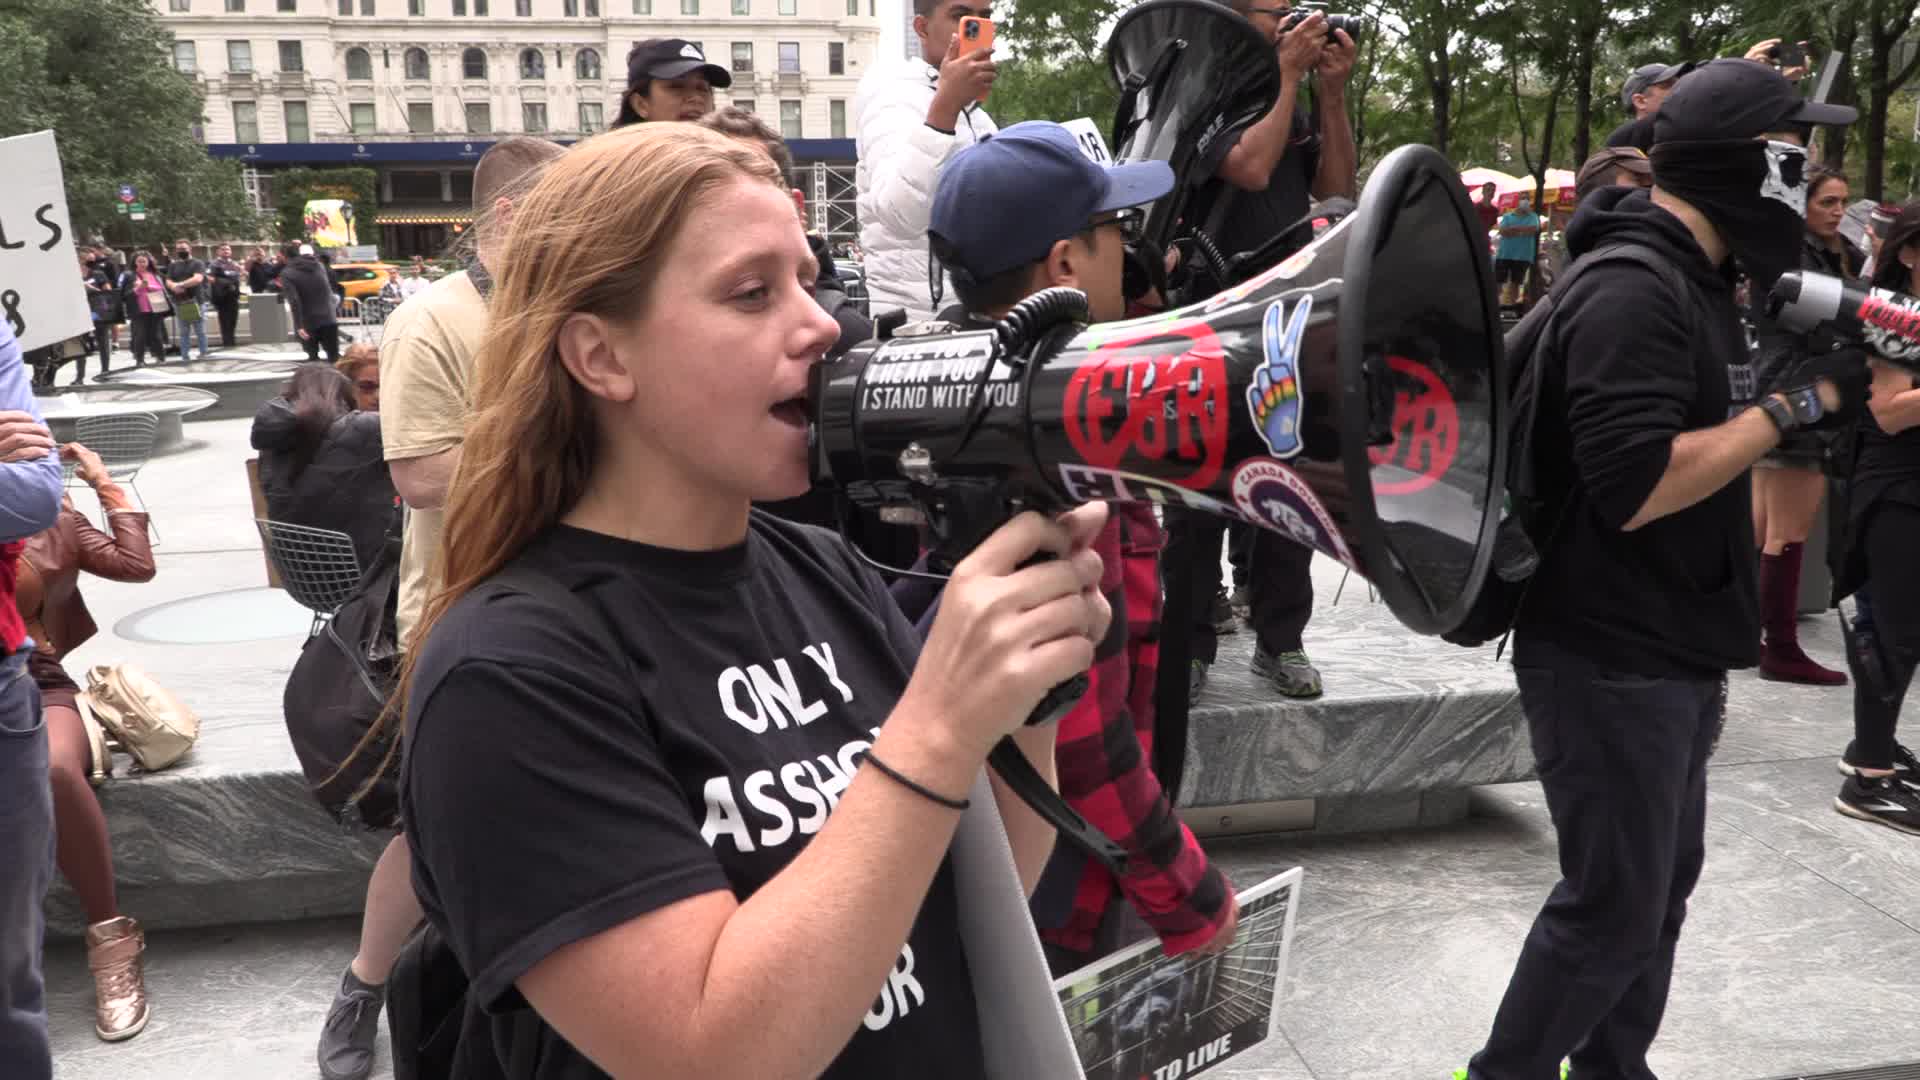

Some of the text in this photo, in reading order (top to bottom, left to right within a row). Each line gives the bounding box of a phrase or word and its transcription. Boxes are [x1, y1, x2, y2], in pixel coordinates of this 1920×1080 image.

[940, 358, 980, 383] YOU
[862, 383, 1020, 410] I STAND WITH YOU
[1240, 465, 1285, 485] CANADA
[717, 642, 853, 734] ONLY
[700, 726, 881, 852] ASSHO
[1153, 1032, 1233, 1080] TO LIVE
